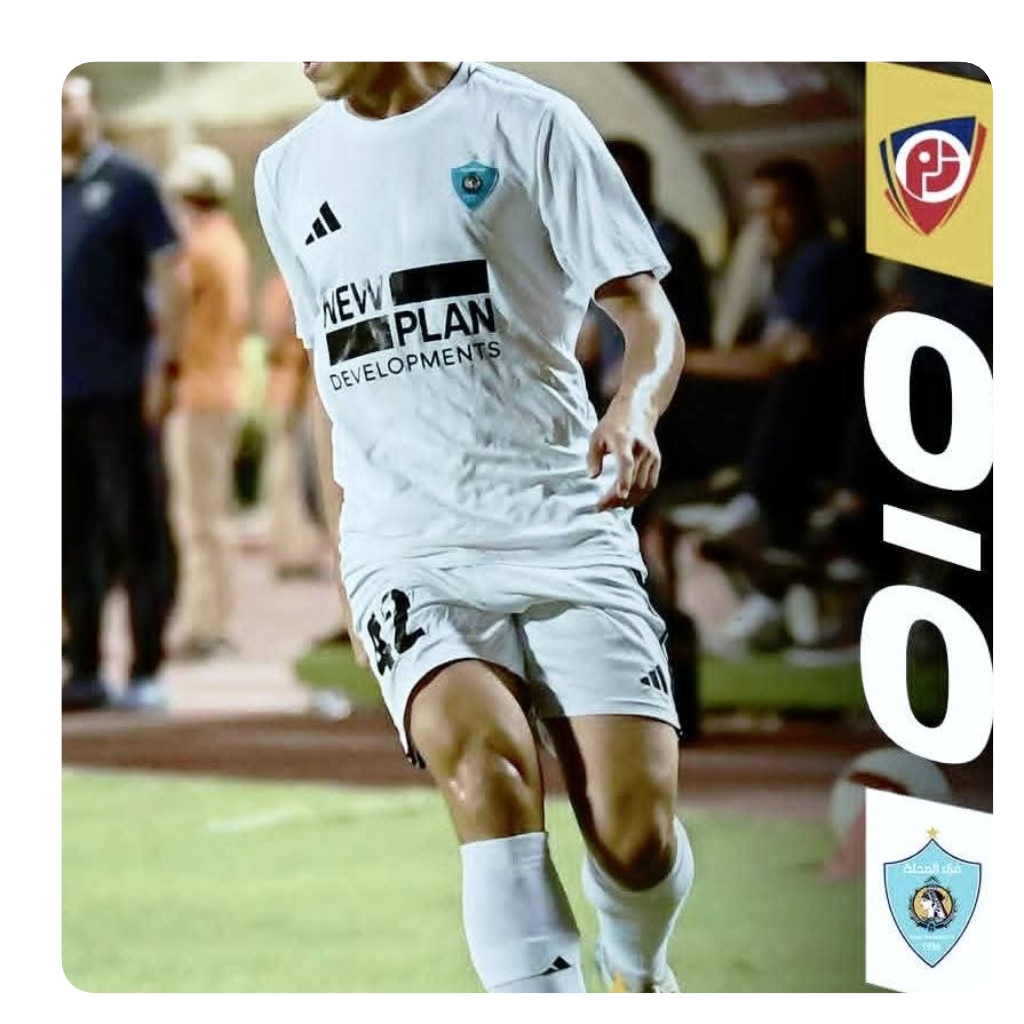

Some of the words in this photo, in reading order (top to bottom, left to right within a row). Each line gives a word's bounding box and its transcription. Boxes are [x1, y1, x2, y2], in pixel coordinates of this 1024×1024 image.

[323, 274, 383, 328] NEW
[394, 297, 496, 346] PLAN
[329, 341, 501, 391] DEVELOPMENTS
[367, 588, 426, 676] 42
